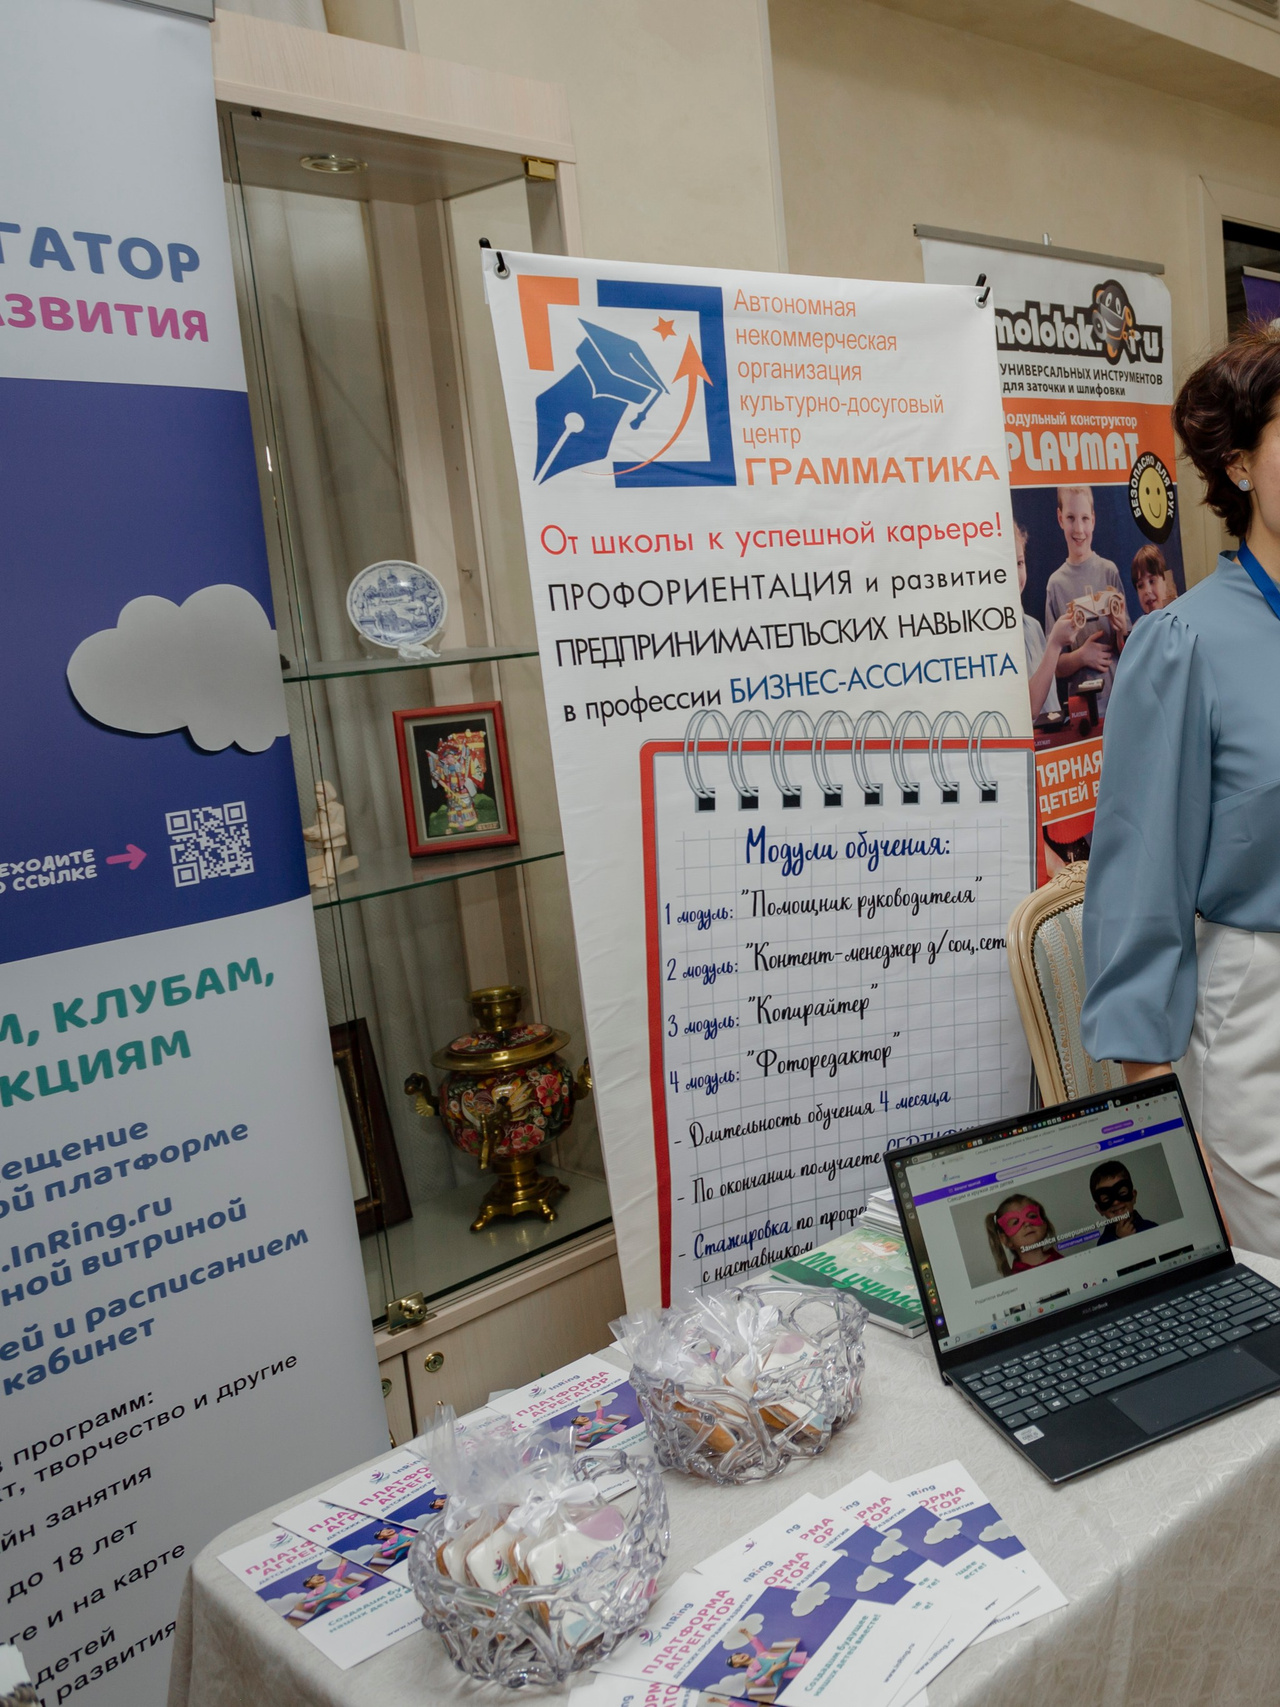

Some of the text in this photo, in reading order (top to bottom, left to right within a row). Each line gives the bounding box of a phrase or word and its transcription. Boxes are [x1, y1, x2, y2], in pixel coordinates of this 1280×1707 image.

[0, 293, 209, 342] ЗВИТИЯ
[733, 289, 856, 317] Автономная
[736, 328, 897, 353] некоммерческая
[737, 360, 862, 385] организация
[1000, 363, 1163, 385] УНИВЕРСАЛЬНЫХ ИНСТРУМЕНТОВ
[1003, 381, 1126, 398] для заточки и шлифовки
[740, 394, 944, 418] культурно-досуговый
[1070, 414, 1138, 430] конструктор
[742, 426, 801, 449] центр
[1005, 430, 1139, 473] PLAYMAT
[745, 455, 1000, 486] ГРАММАТИКА
[1130, 455, 1155, 518] БЕЗОПАСНО
[1156, 461, 1172, 487] ДЛЯ
[540, 512, 1003, 557] От школы к успешной карьере!
[548, 567, 1008, 612] ПРОФОРИЕНТАЦИЯ и развитие
[555, 606, 1017, 669] ПРЕДПРИНИМАТЕЛЬСКИХ НАВЫКОВ
[563, 653, 1019, 726] в профессии БИЗНЕС-АССИСТЕНТА
[1038, 781, 1089, 815] ДЕТЕЙ
[746, 825, 951, 877] Модули обучения:
[13, 864, 98, 892] ССЫЛКЕ
[665, 903, 672, 926] 1
[677, 906, 734, 931] модуль:
[667, 958, 677, 982] 2
[682, 962, 739, 985] модуль:
[53, 957, 274, 1033] КЛУБАМ,
[668, 1014, 679, 1038] 3
[683, 1017, 740, 1040] модуль:
[0, 1030, 191, 1107] КЦИЯМ
[669, 1070, 681, 1094] 4
[685, 1071, 741, 1096] модуль:
[689, 1088, 952, 1148] Длительность обучения 4 месяца
[44, 1123, 249, 1202] платформе
[691, 1154, 882, 1205] По окончании получаете
[1, 1197, 247, 1306] ной витриной
[693, 1205, 868, 1260] Стажировка по профе
[1020, 1211, 1130, 1253] Занимайся совершенно бесплатно!
[53, 1317, 76, 1339] и
[85, 1229, 309, 1333] расписанием
[702, 1241, 814, 1284] с наставником
[798, 1251, 849, 1280] Мы
[2, 1318, 155, 1396] кабинет
[516, 1371, 609, 1417] ПЛАТФОРМА
[531, 1377, 609, 1418] АГРЕГАТОР
[548, 1374, 580, 1391] InRing
[13, 1391, 155, 1466] программ:
[34, 1354, 298, 1482] творчество и другие
[46, 1466, 152, 1530] занятия
[7, 1520, 139, 1603] до 18 лет
[764, 1552, 809, 1586] ОРМА
[47, 1542, 186, 1629] и на карте
[642, 1589, 730, 1674] ПЛАТФОРМА
[661, 1602, 694, 1630] InRing
[664, 1597, 736, 1671] АГРЕГАТОР
[35, 1628, 116, 1690] детей
[56, 1620, 177, 1706] развития
[804, 1615, 869, 1692] Создадим будущее
[813, 1669, 839, 1697] наших
